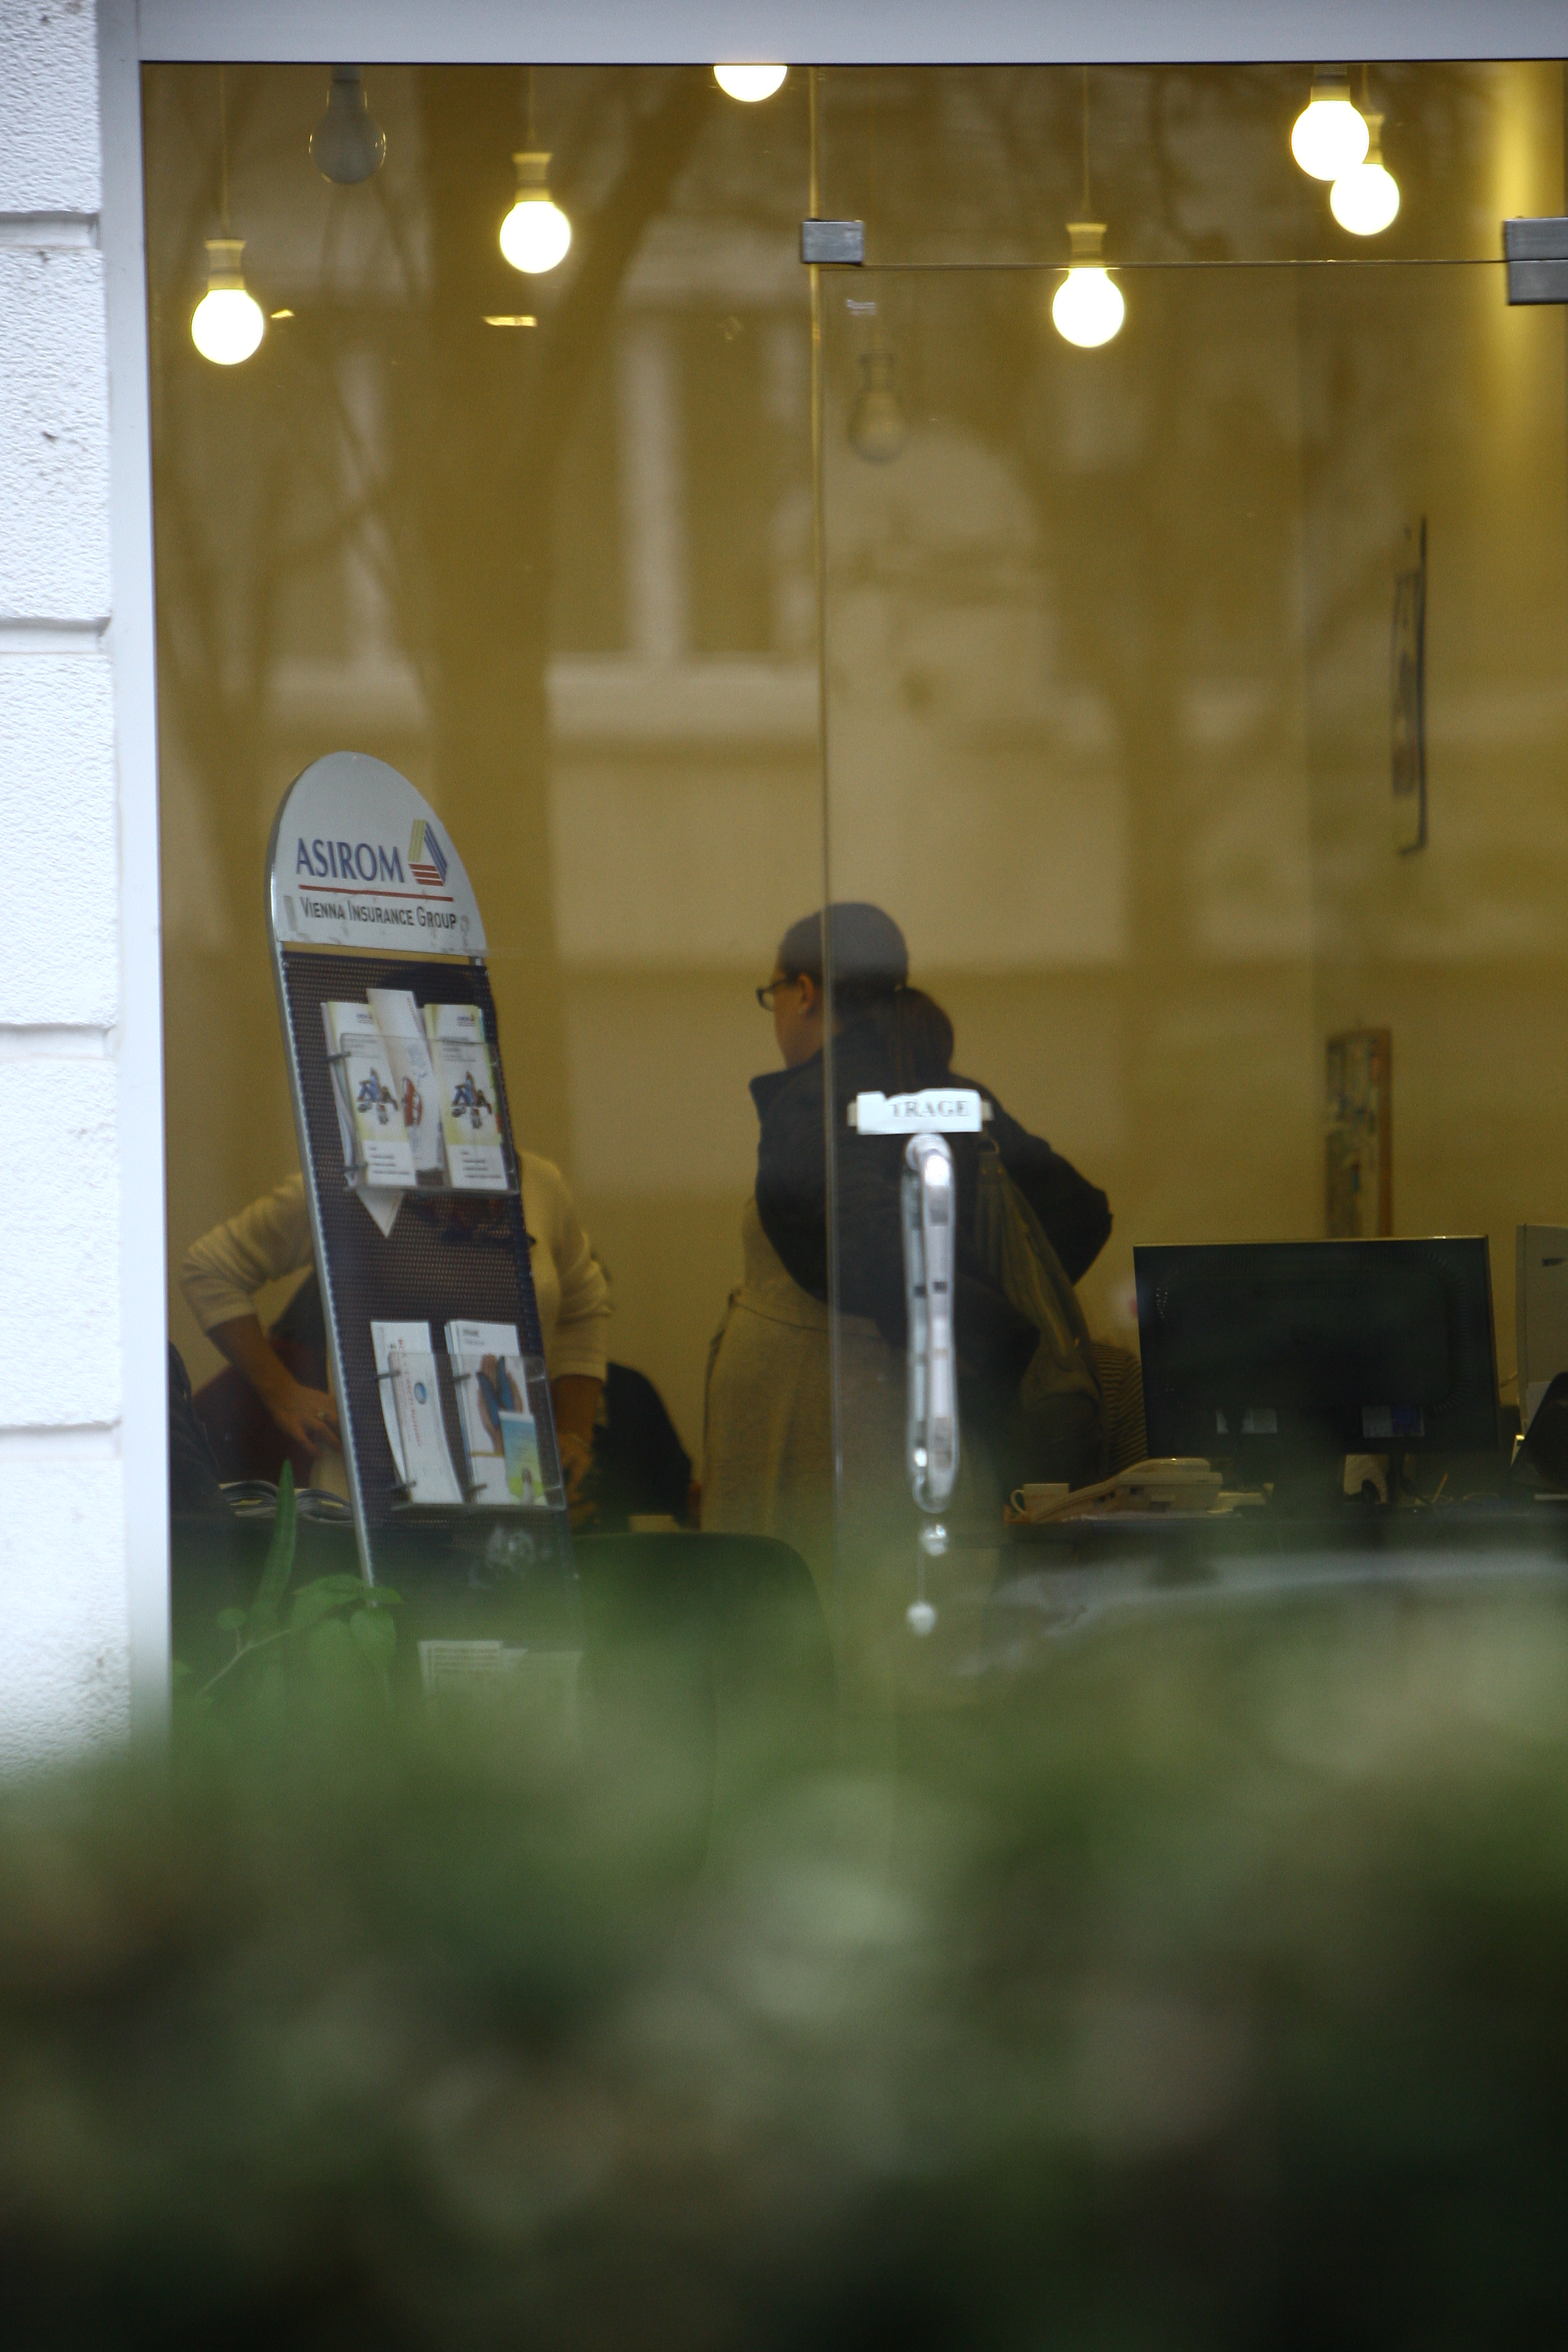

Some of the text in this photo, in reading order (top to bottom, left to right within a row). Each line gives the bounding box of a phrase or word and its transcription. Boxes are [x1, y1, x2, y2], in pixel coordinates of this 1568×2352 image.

[296, 838, 404, 883] ASIROM
[300, 897, 456, 929] VIENNA INSURANCE GROUP
[888, 1100, 970, 1117] TRAGE
